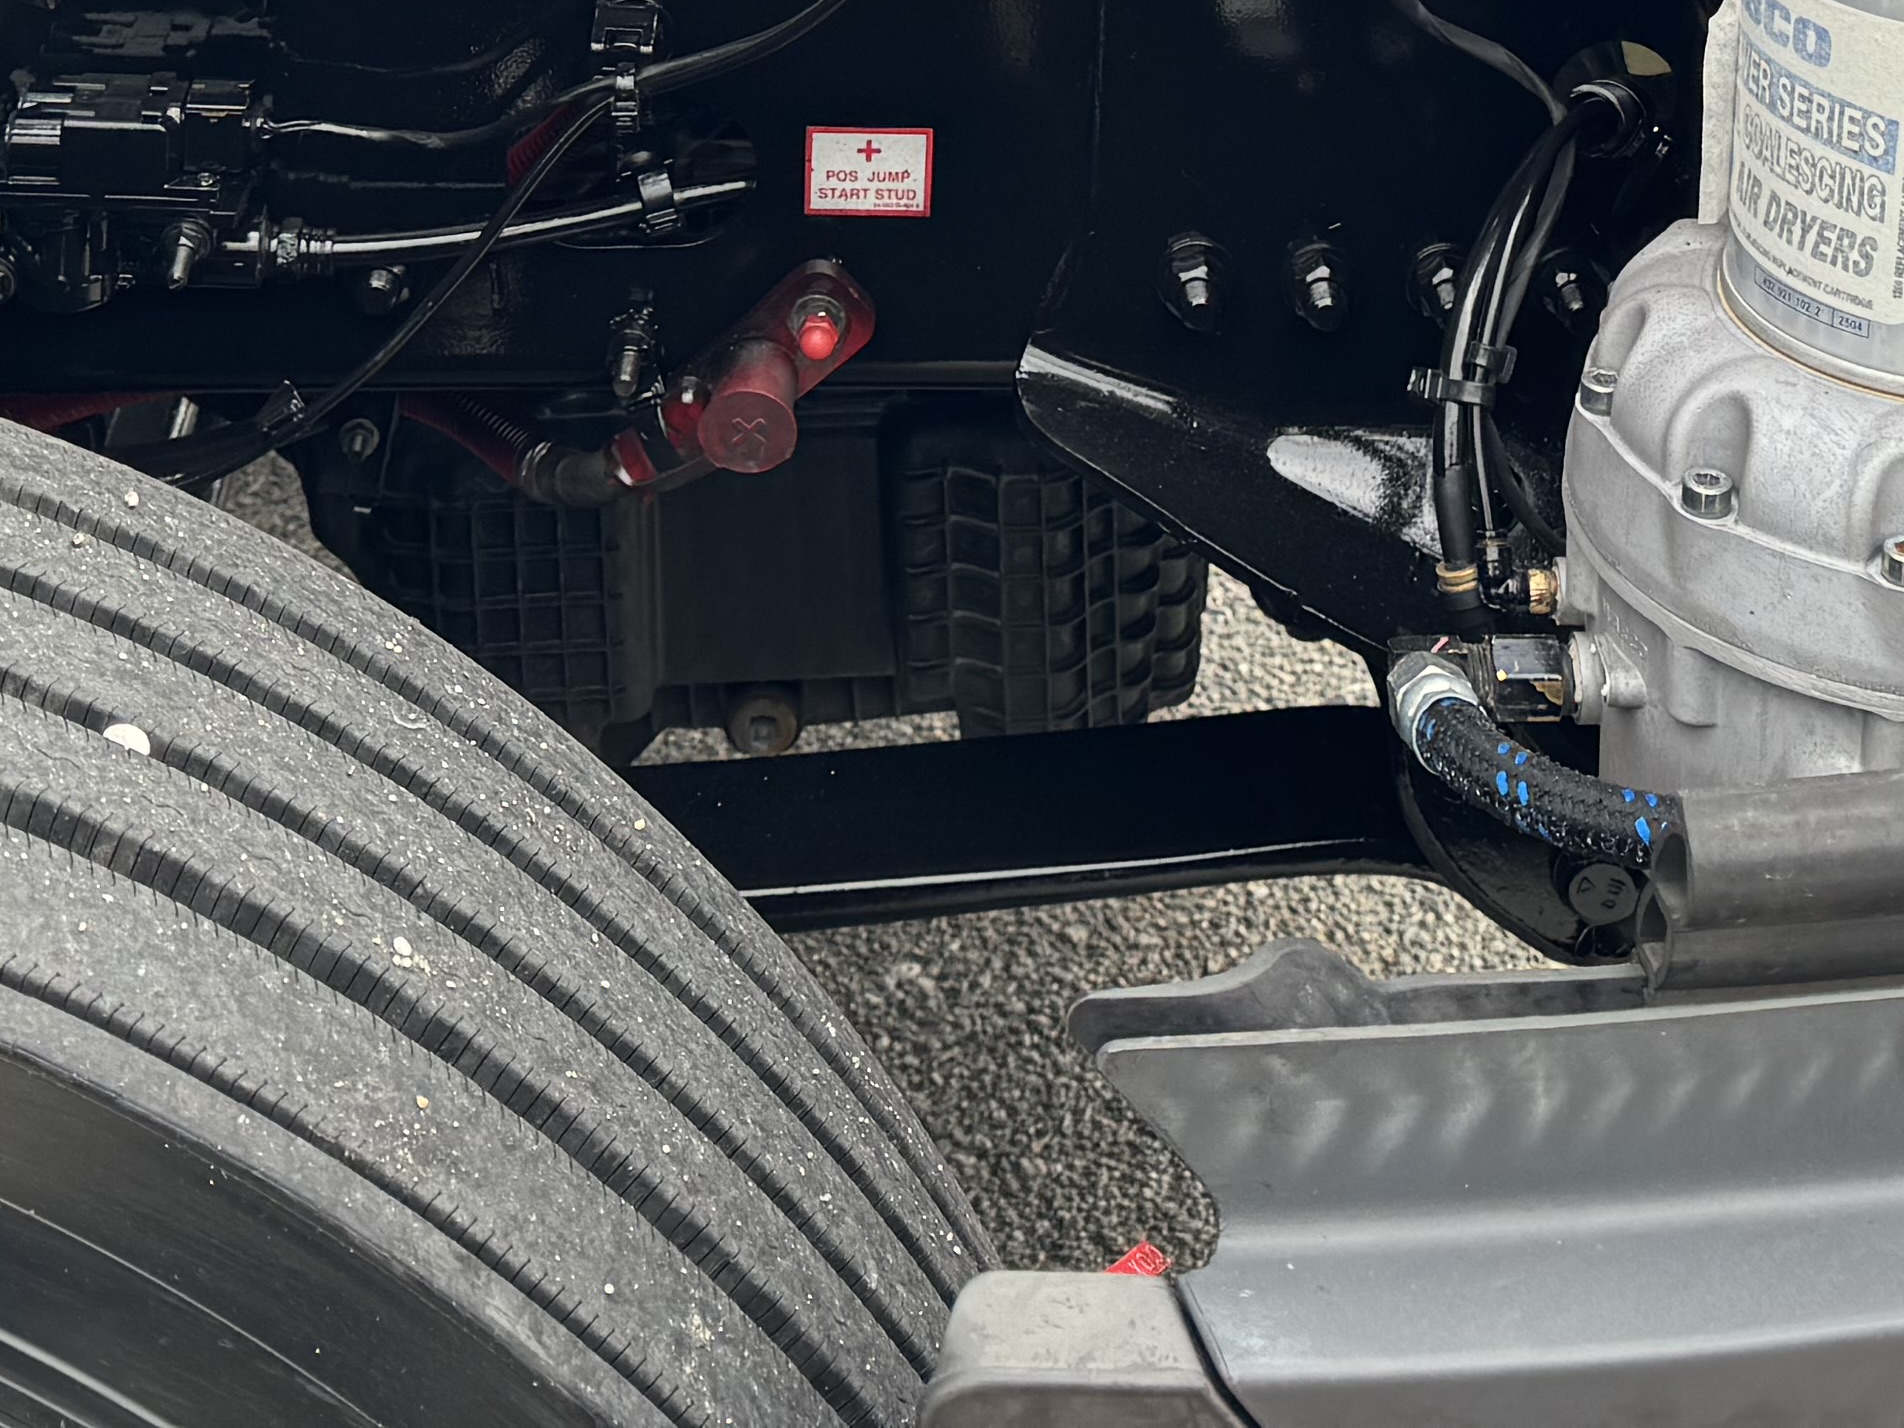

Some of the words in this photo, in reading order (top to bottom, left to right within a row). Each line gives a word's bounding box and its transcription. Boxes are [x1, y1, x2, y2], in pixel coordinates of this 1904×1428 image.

[1776, 75, 1887, 158] SERIES
[1743, 103, 1888, 225] COALESCING
[826, 169, 859, 182] POS
[866, 170, 911, 183] JUMP
[817, 187, 871, 201] START
[874, 188, 917, 201] STUD
[1736, 159, 1764, 218] AIR
[1763, 187, 1879, 279] DRYERS
[1795, 293, 1811, 313] 102
[1838, 313, 1864, 333] 2504
